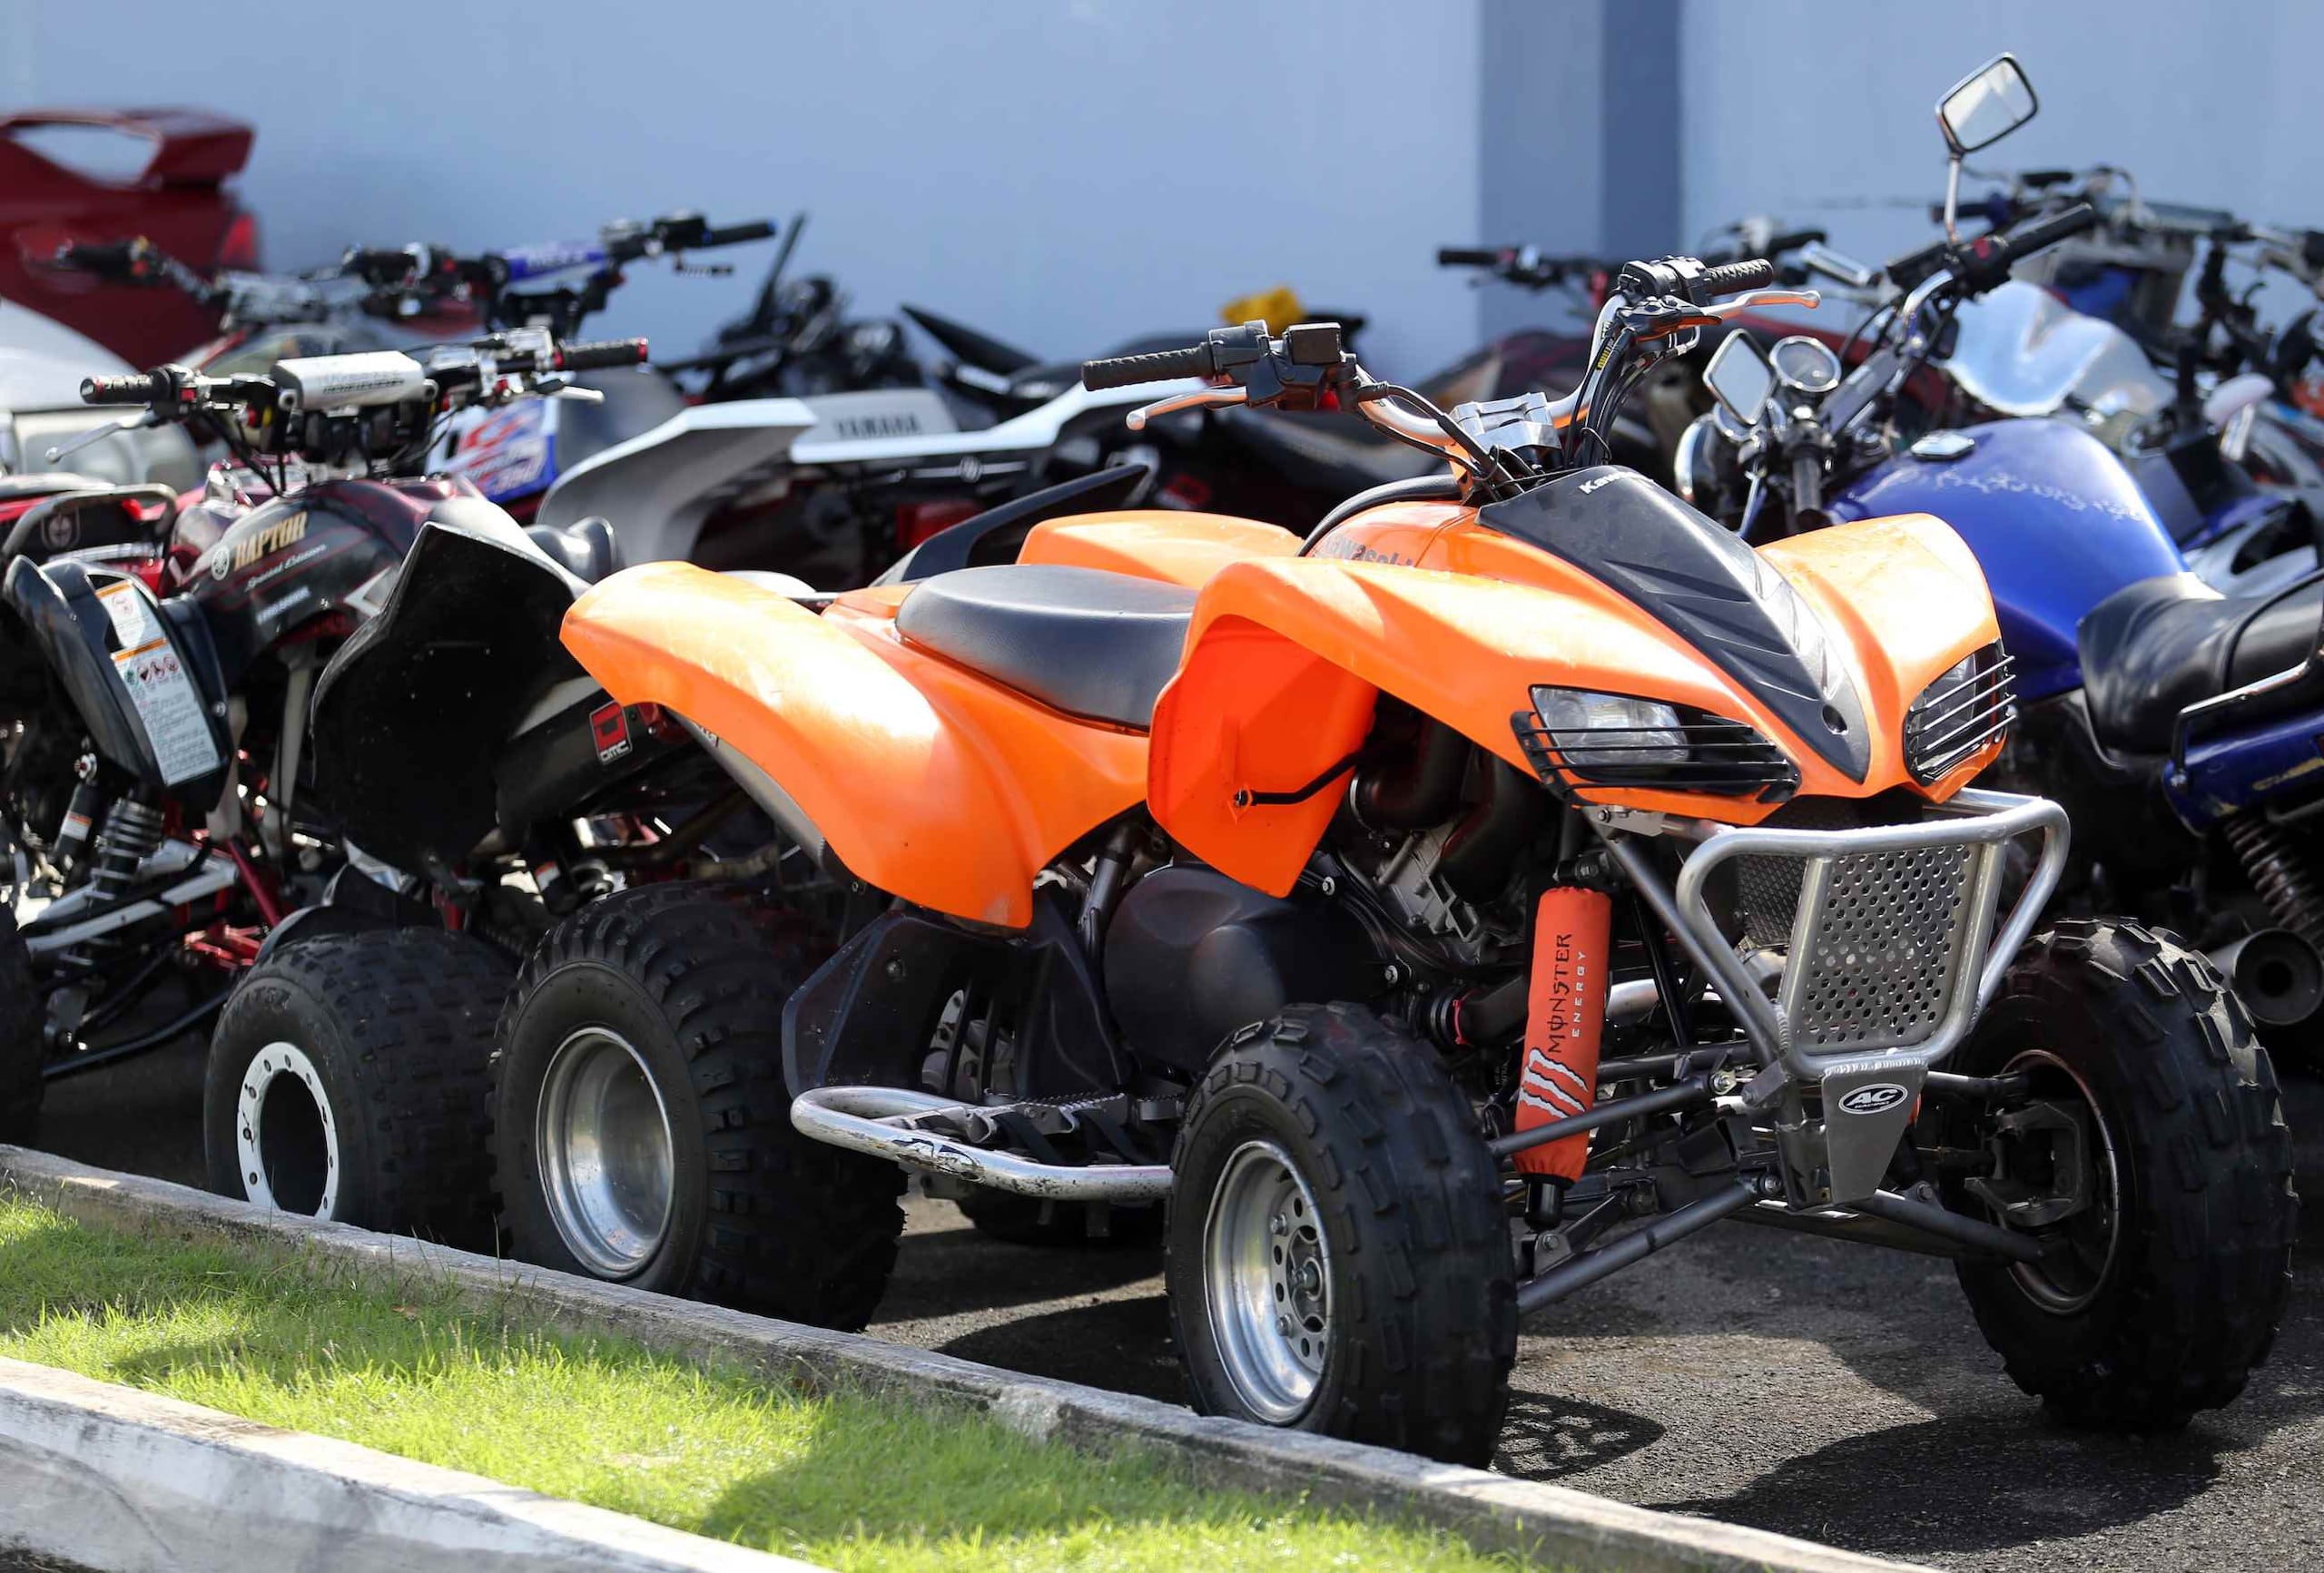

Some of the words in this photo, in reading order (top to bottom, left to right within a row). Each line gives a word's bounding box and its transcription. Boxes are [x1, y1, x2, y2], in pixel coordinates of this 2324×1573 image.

[832, 414, 921, 440] YAMAHA
[233, 511, 308, 572] RAPTOR
[600, 740, 630, 762] DMC
[1547, 933, 1572, 1053] MONSTER
[1571, 950, 1587, 1037] ENERGY
[1846, 1089, 1899, 1106] AC
